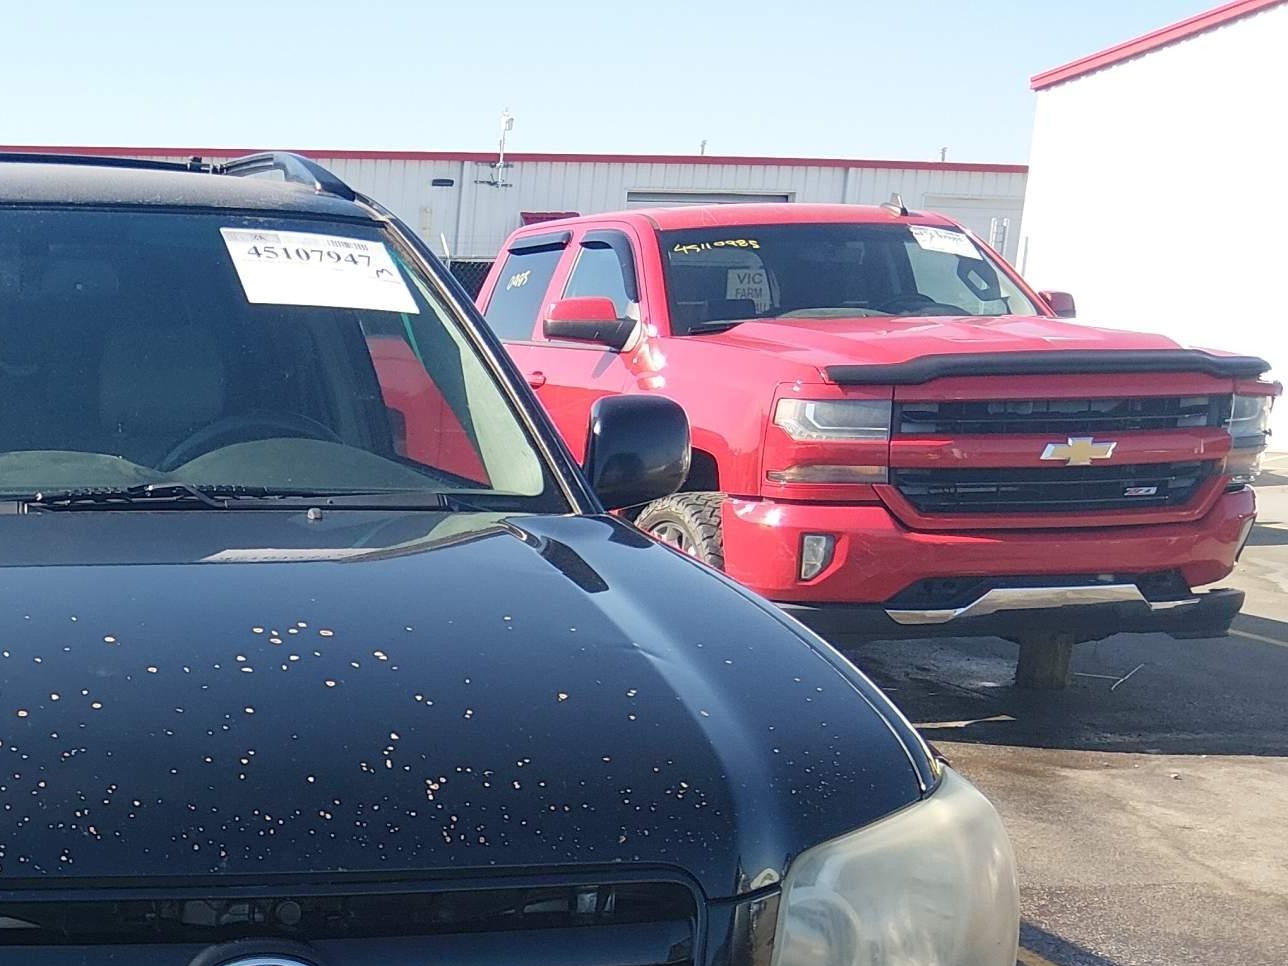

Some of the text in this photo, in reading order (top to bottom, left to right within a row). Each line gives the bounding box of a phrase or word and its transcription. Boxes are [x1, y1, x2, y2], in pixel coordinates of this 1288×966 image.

[247, 245, 371, 267] 45107947
[737, 273, 763, 285] VIC
[735, 287, 763, 299] FARM
